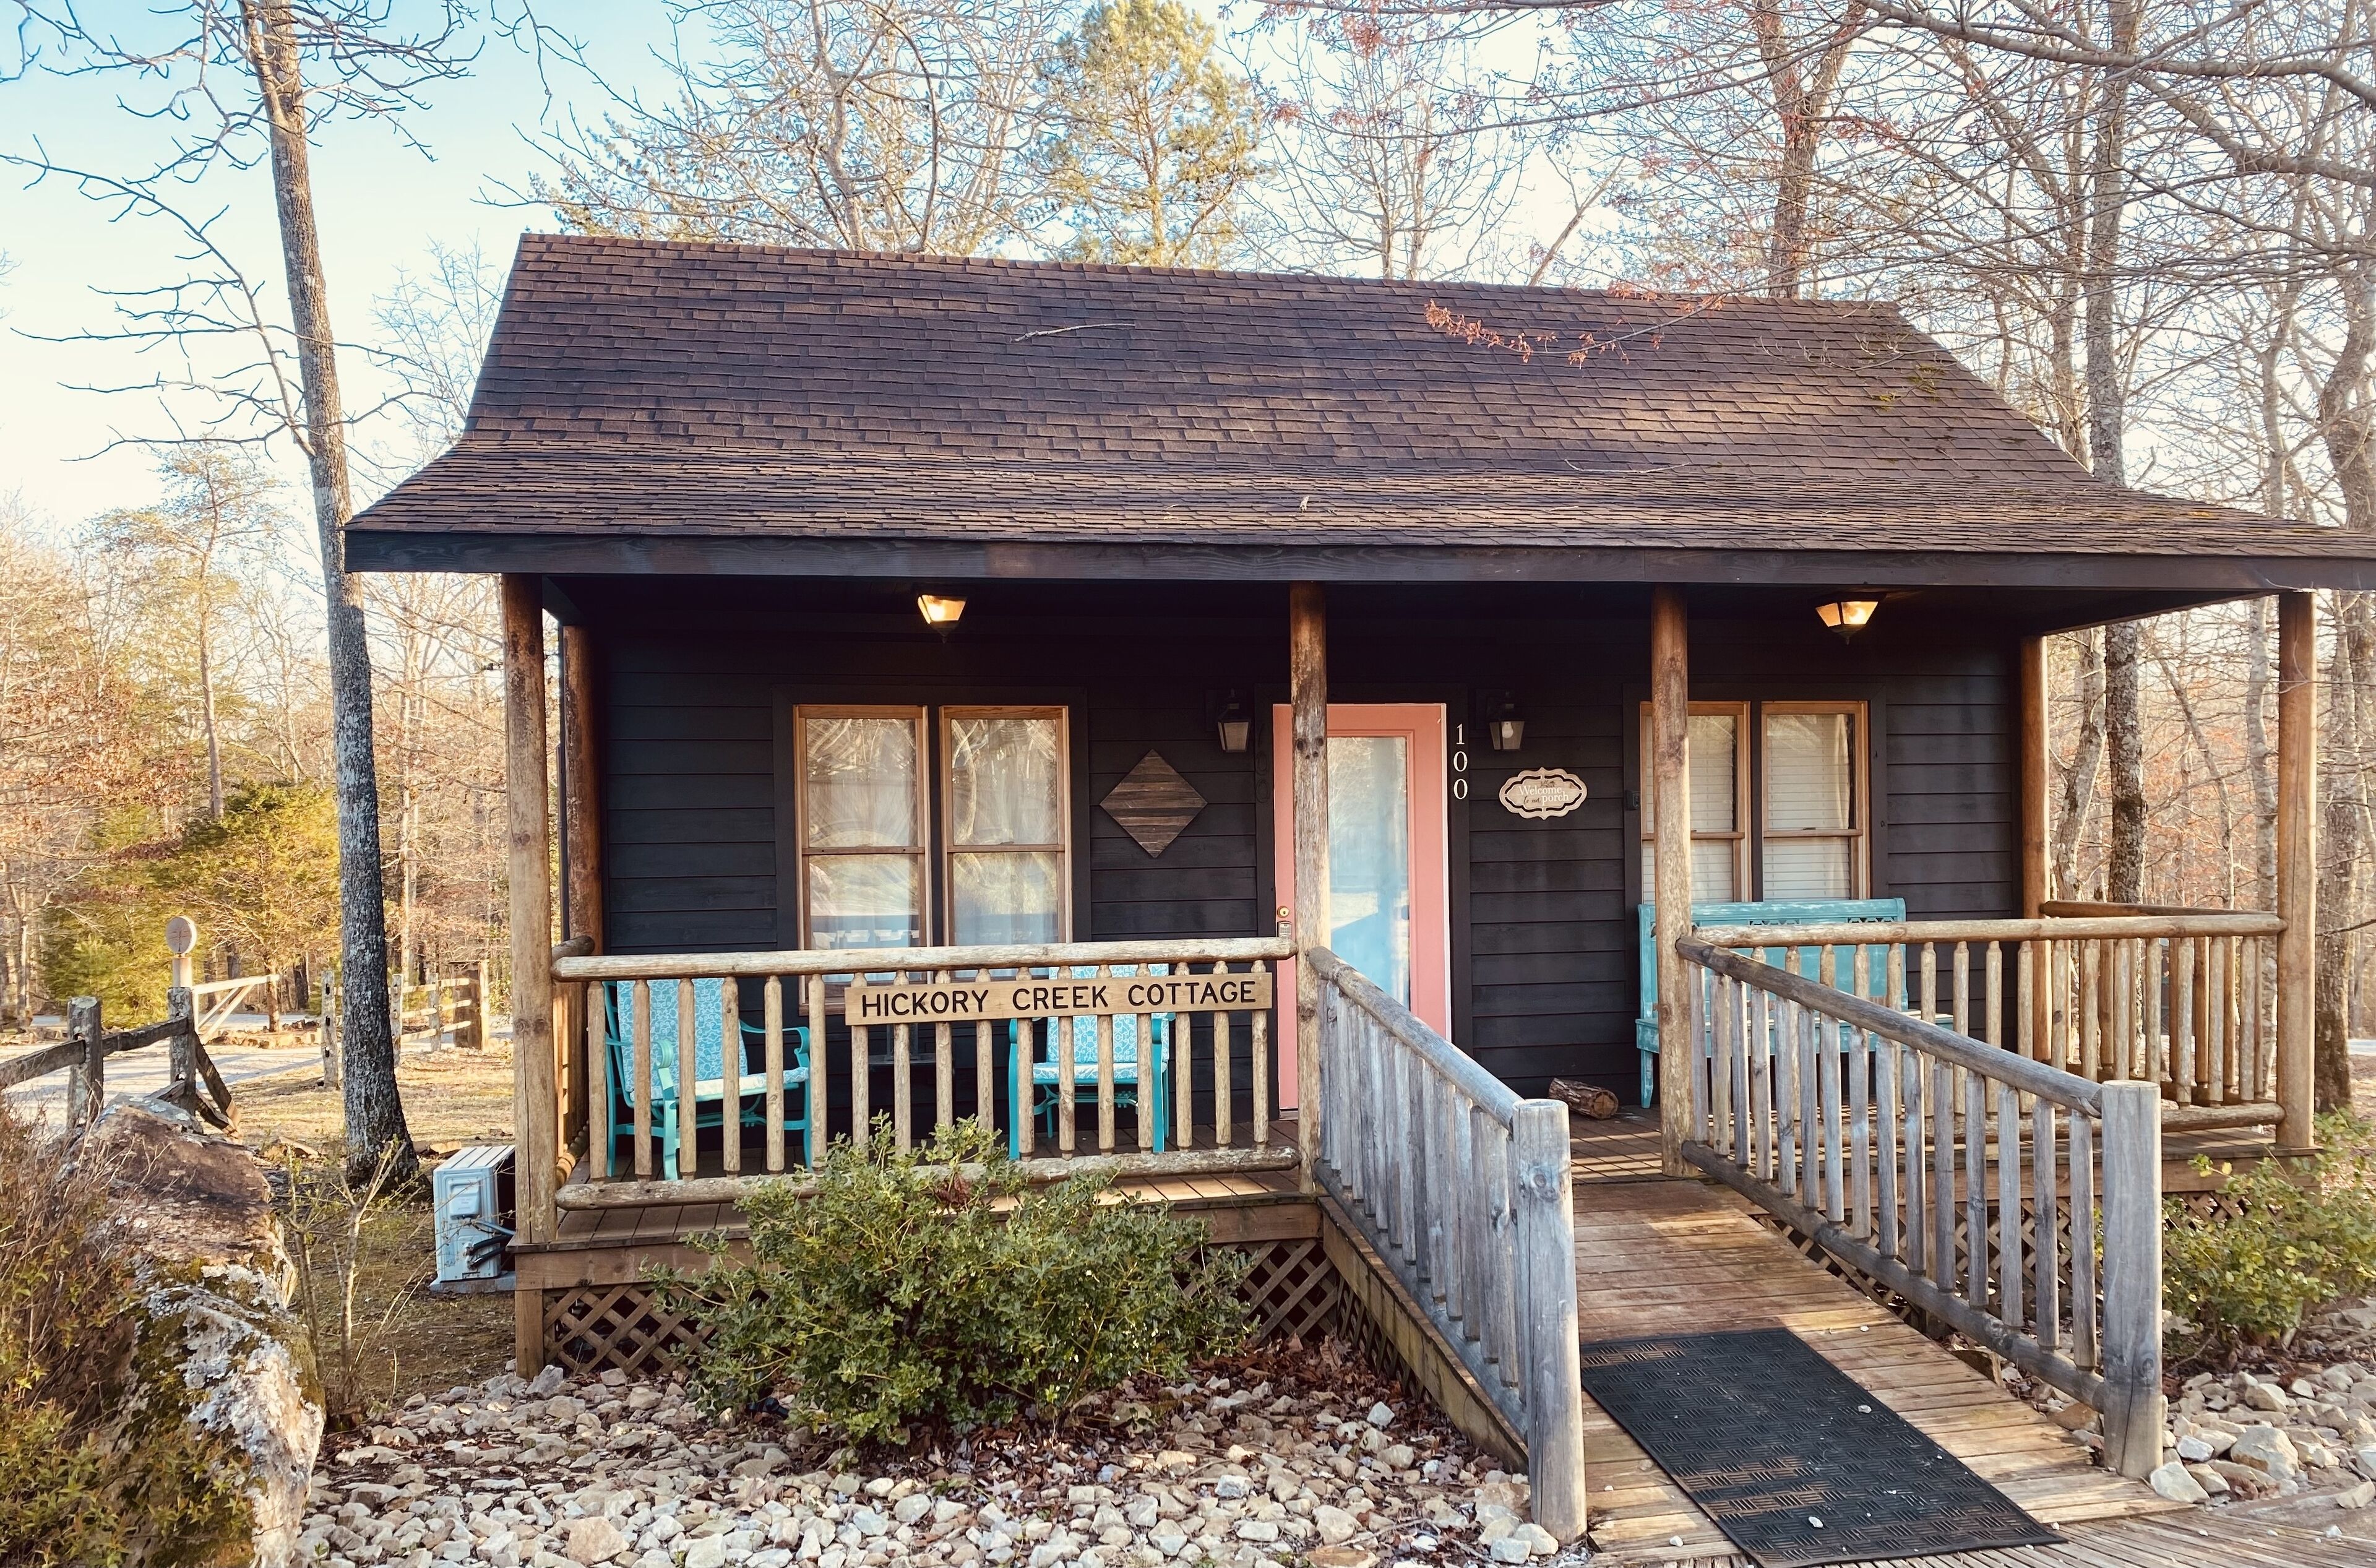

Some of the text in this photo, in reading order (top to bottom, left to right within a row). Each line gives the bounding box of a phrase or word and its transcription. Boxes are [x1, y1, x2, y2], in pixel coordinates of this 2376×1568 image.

[1453, 723, 1468, 799] 100
[1518, 785, 1563, 796] Welcome
[1541, 791, 1569, 806] porch
[861, 980, 1257, 1018] HICKORY CREEK COTTAGE
